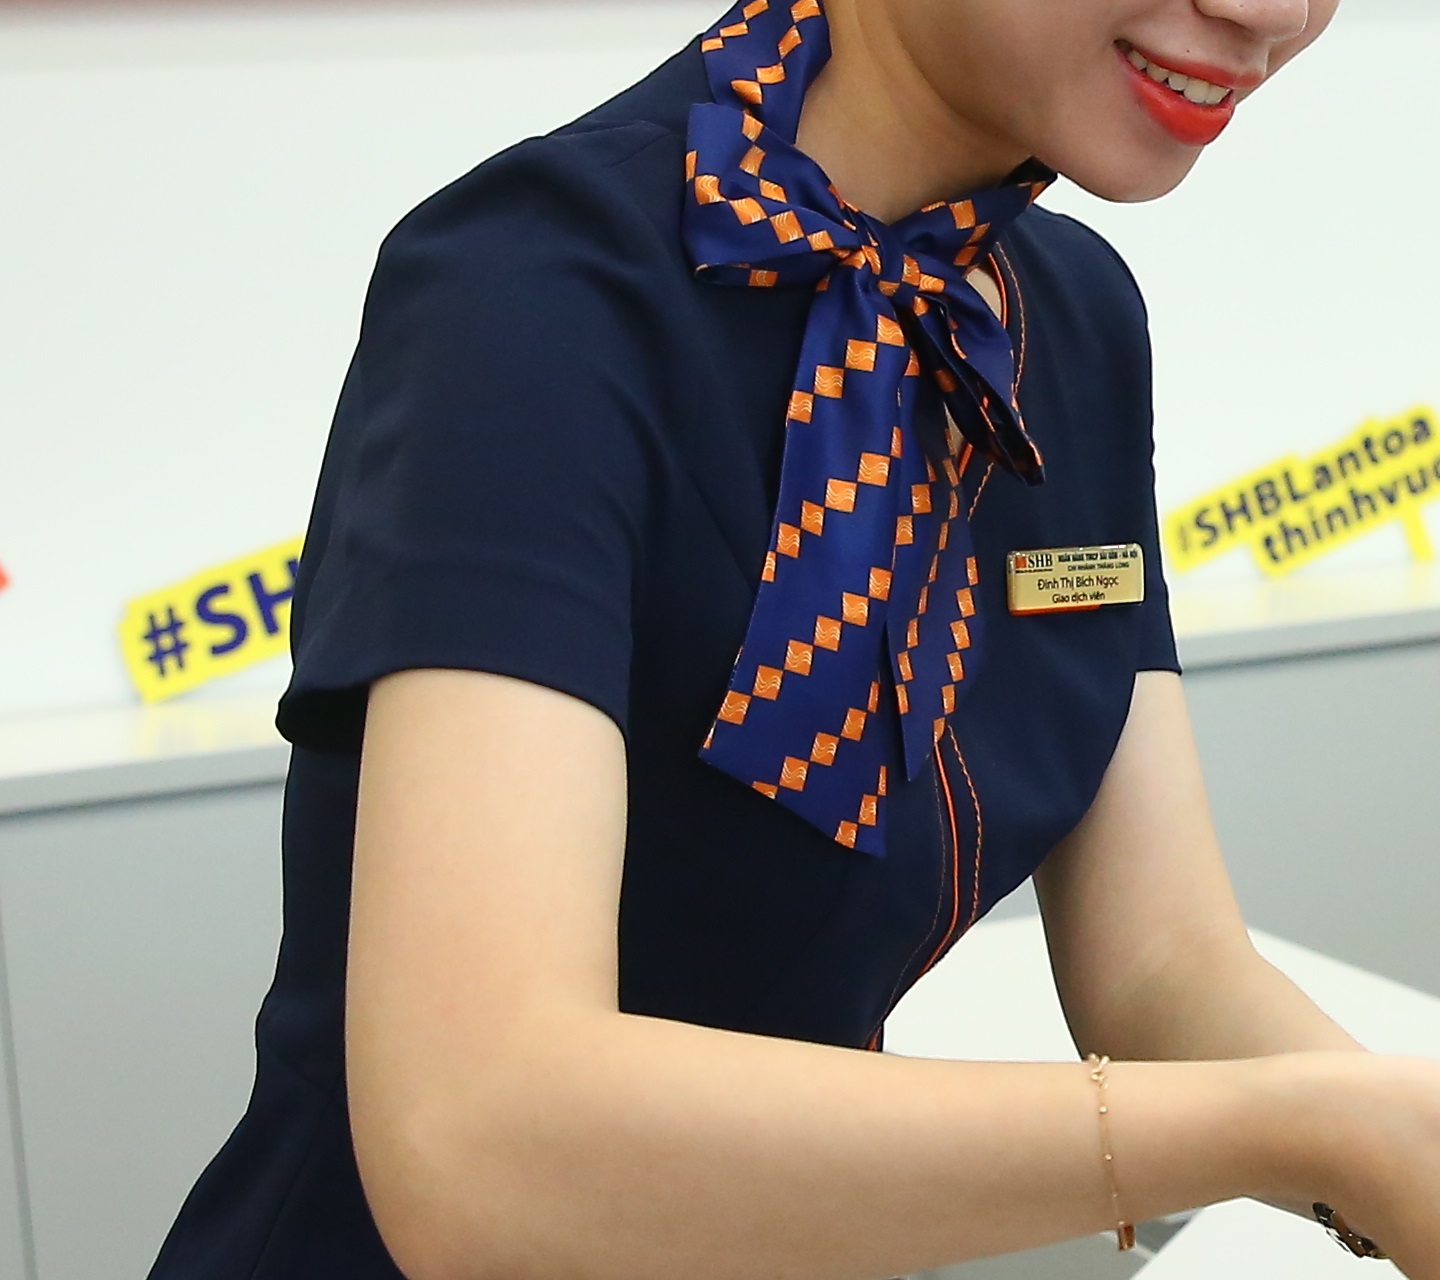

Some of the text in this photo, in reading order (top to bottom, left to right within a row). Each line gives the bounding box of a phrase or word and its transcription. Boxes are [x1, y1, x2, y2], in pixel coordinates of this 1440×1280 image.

[1027, 553, 1053, 568] SHB
[1096, 575, 1119, 588] Ngọc
[1052, 593, 1070, 603] Giao
